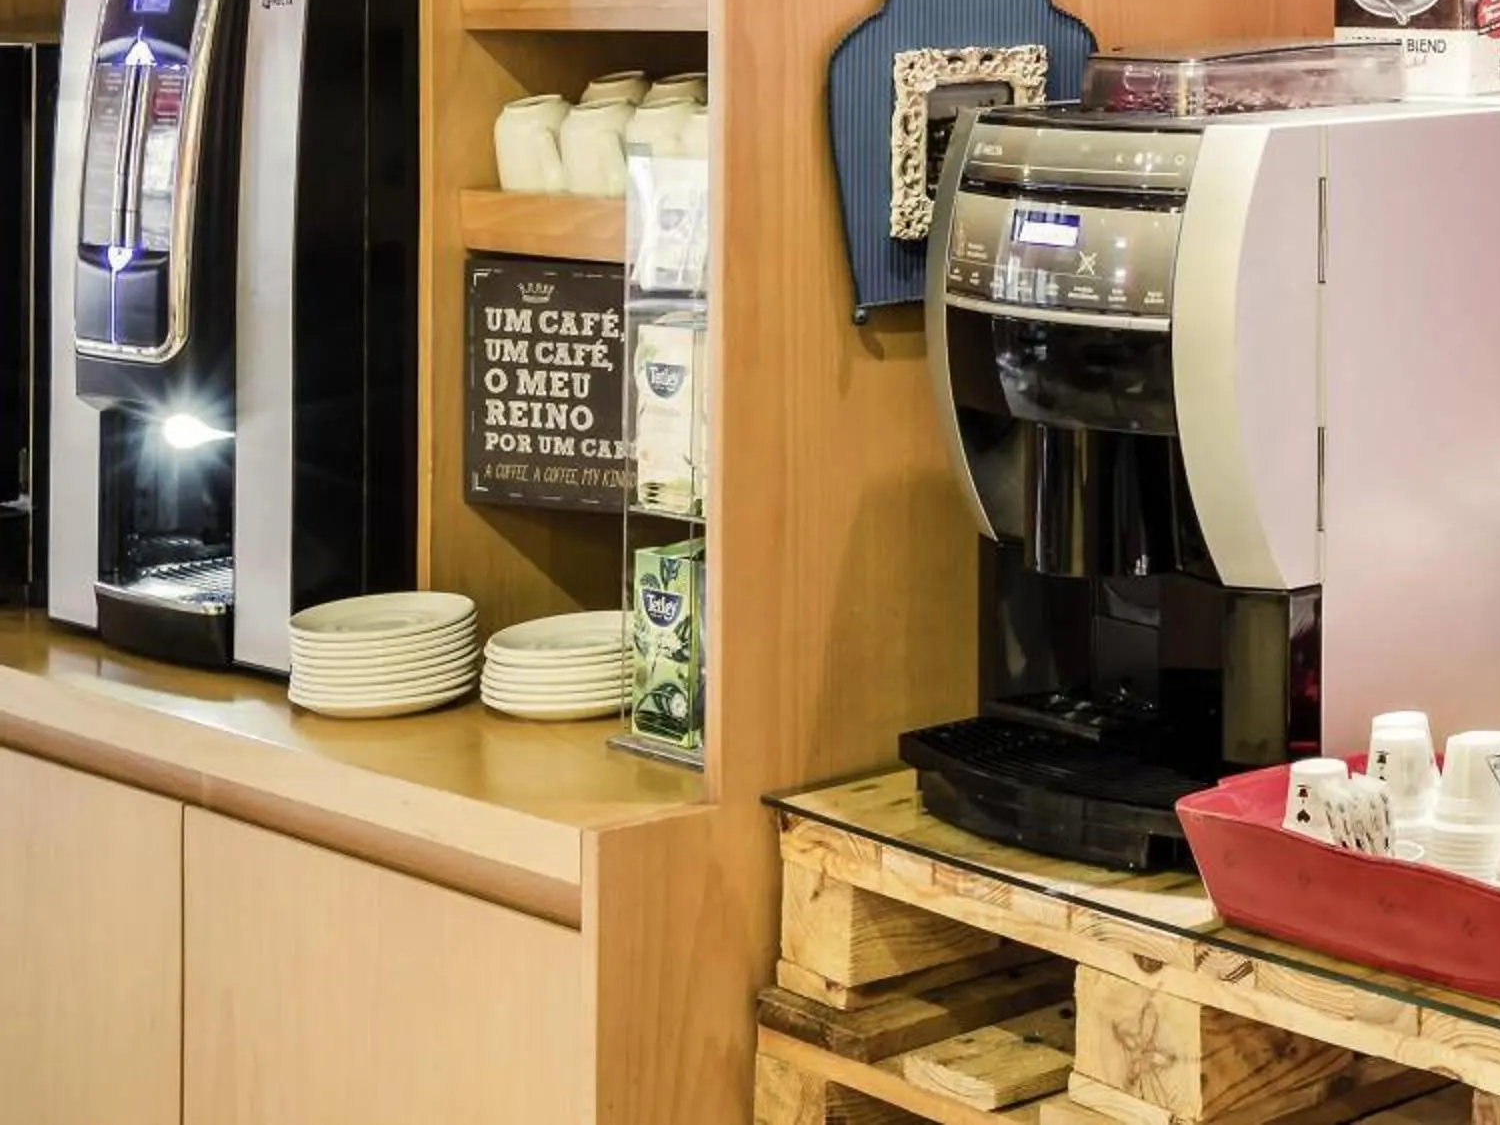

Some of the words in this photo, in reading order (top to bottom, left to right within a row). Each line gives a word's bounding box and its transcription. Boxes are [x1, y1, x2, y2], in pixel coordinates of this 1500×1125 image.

[484, 307, 533, 334] UM
[538, 308, 625, 342] CAFÉ,
[484, 338, 529, 364] UM
[534, 339, 614, 372] CAFÉ,
[484, 368, 509, 394] O
[515, 369, 592, 398] MEU
[484, 398, 595, 432] REINO
[484, 431, 533, 453] POR
[537, 435, 576, 456] UM
[646, 593, 679, 620] Tetley
